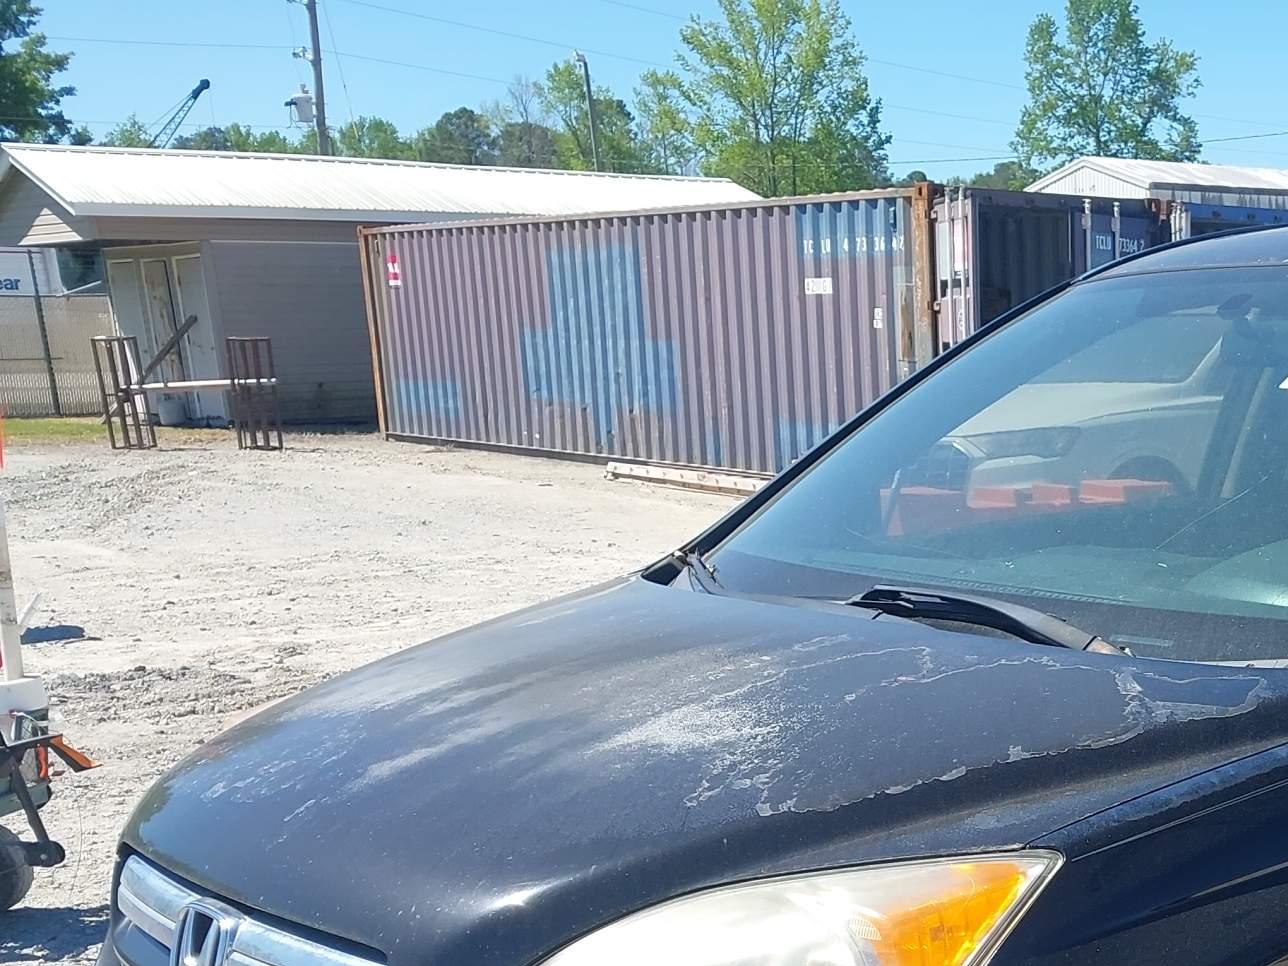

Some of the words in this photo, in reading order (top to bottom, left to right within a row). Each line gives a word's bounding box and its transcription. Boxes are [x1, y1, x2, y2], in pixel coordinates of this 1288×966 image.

[803, 238, 831, 254] TCLU
[1095, 235, 1112, 250] TCLU
[1118, 238, 1138, 253] 73364
